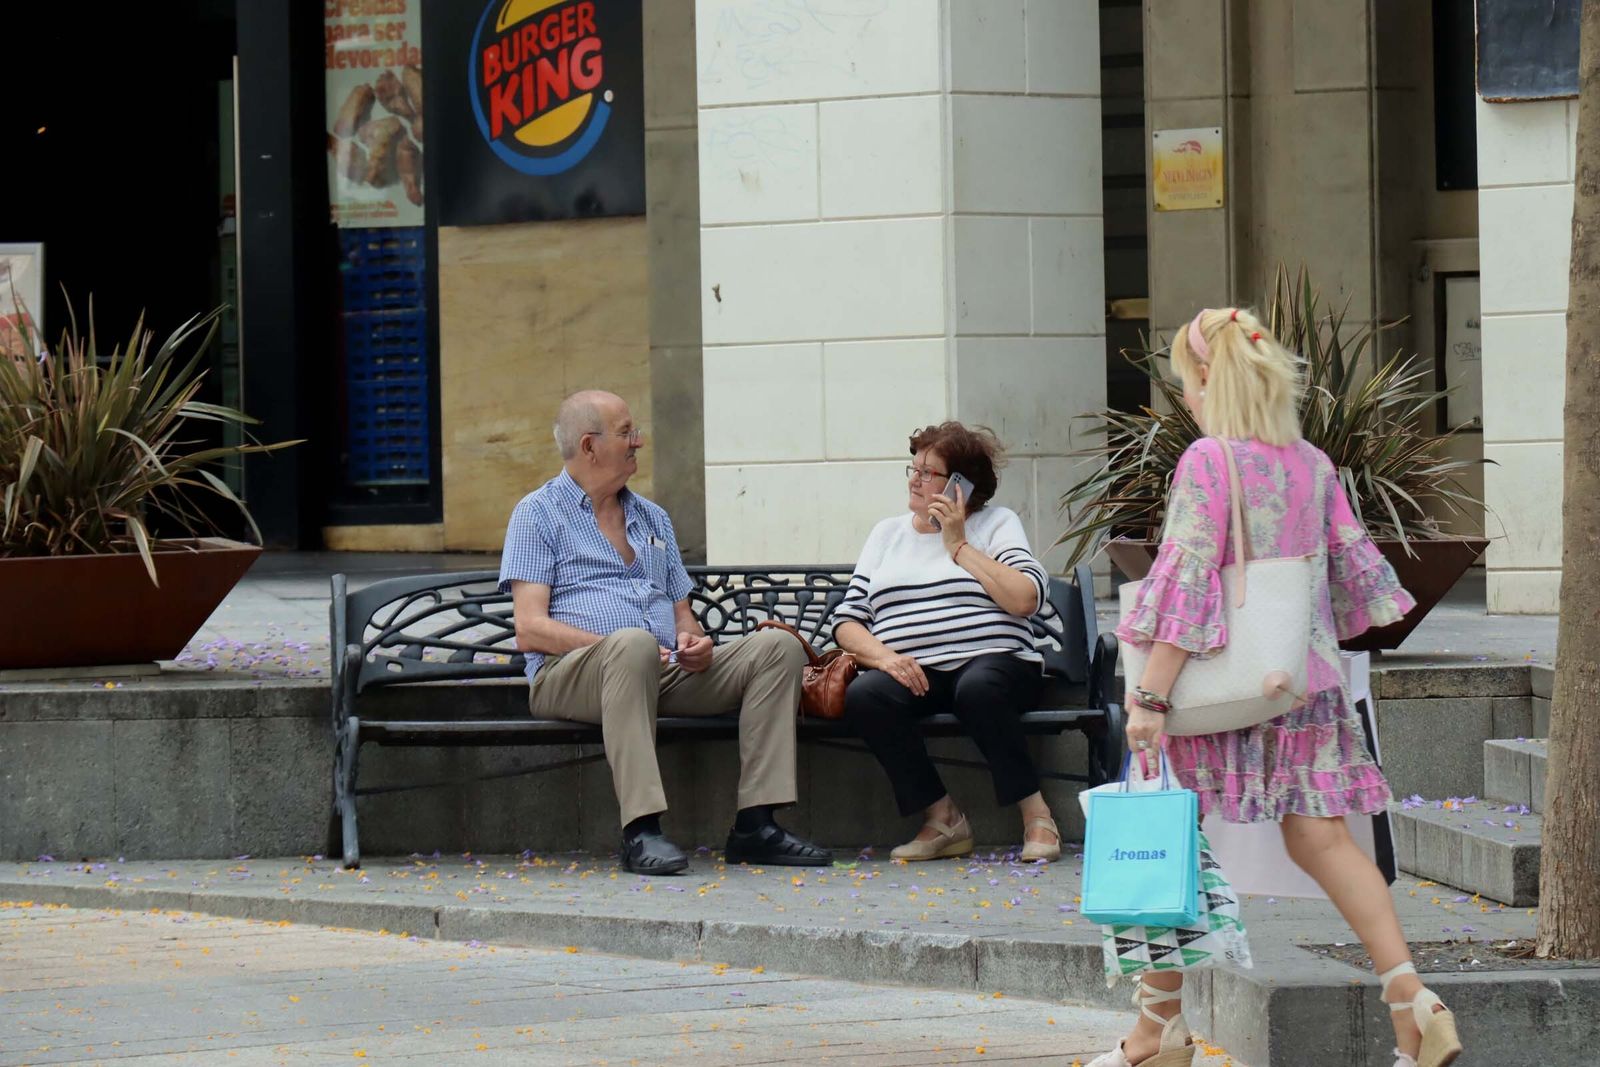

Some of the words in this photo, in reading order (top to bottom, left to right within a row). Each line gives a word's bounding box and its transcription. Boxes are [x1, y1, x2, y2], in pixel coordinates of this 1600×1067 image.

[374, 21, 406, 41] ser
[483, 1, 597, 87] BURGER
[490, 36, 603, 140] KING
[1108, 848, 1167, 861] Aromas
